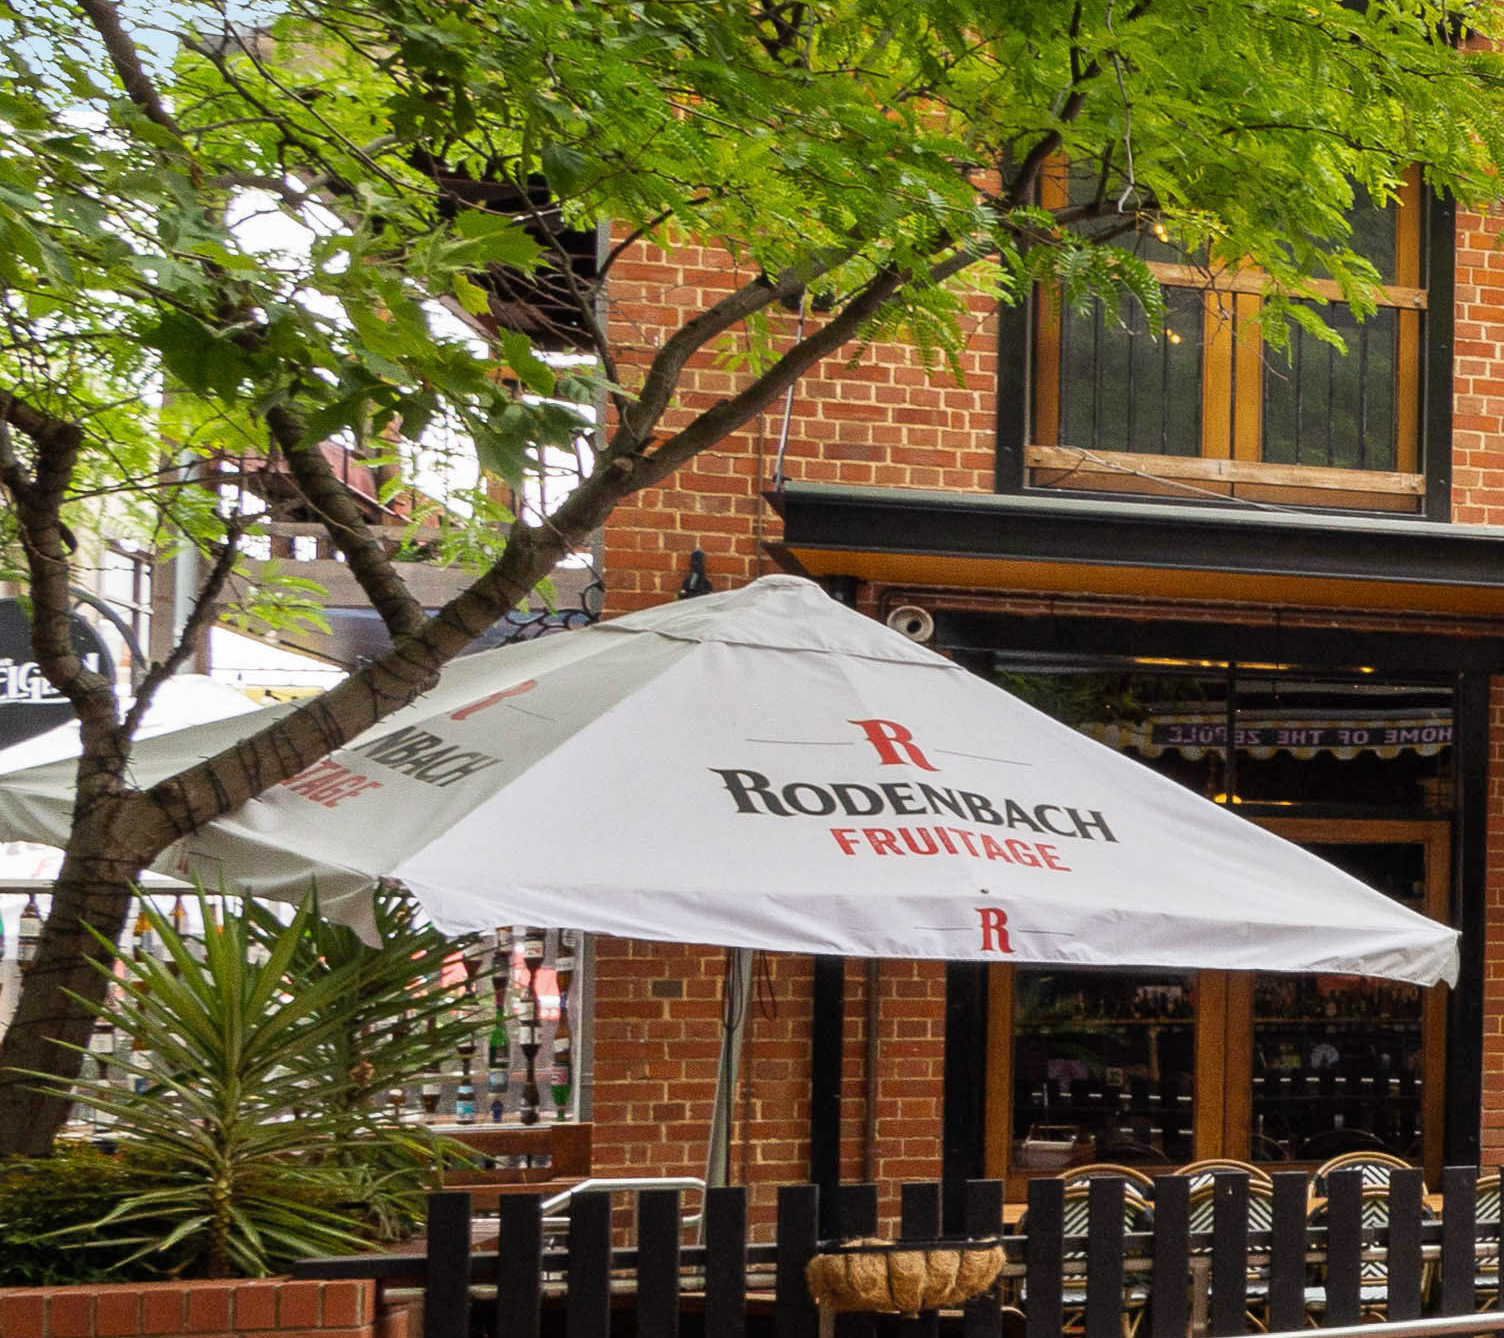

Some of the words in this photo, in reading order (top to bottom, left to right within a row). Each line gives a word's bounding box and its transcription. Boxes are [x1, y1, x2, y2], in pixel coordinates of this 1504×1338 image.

[352, 725, 505, 787] NBACH
[848, 719, 940, 772] R
[279, 760, 384, 808] TAGE
[708, 767, 1120, 843] RODENBACH
[831, 827, 1073, 872] FRUITAGE
[974, 907, 1016, 954] R
